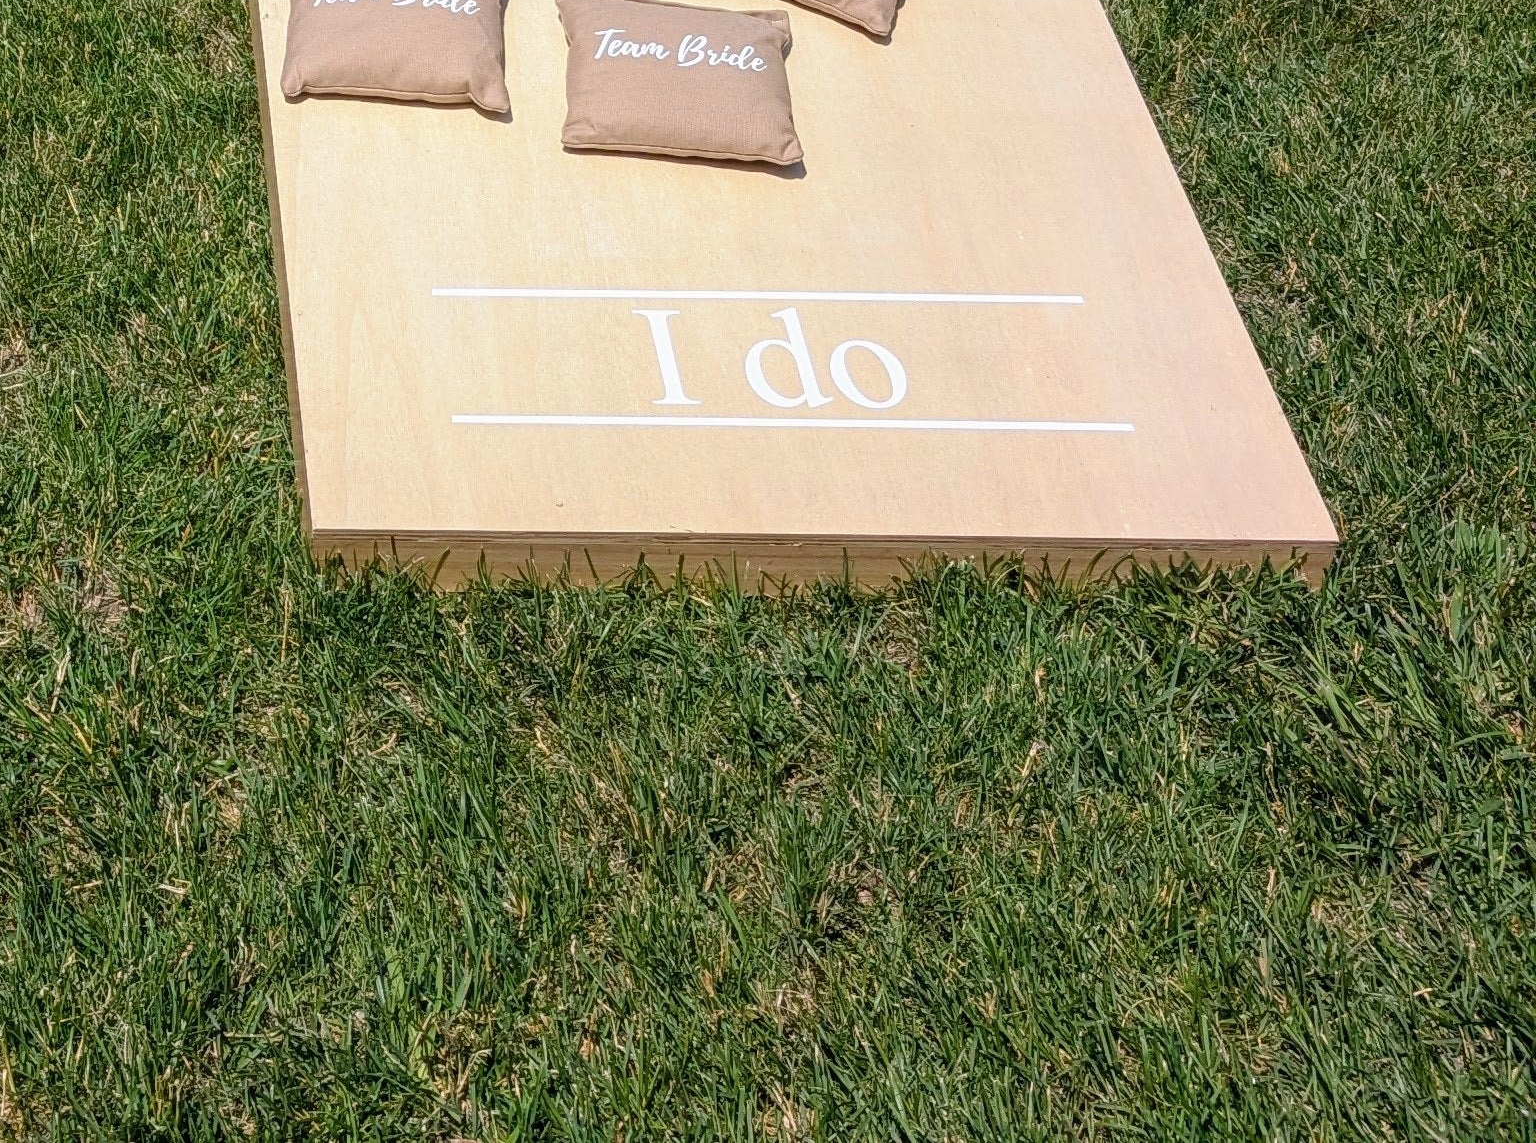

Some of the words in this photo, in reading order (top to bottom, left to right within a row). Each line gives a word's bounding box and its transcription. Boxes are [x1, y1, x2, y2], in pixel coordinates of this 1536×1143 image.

[594, 28, 671, 60] Team
[676, 34, 768, 72] Bride
[631, 309, 702, 405] I
[744, 307, 908, 409] do
